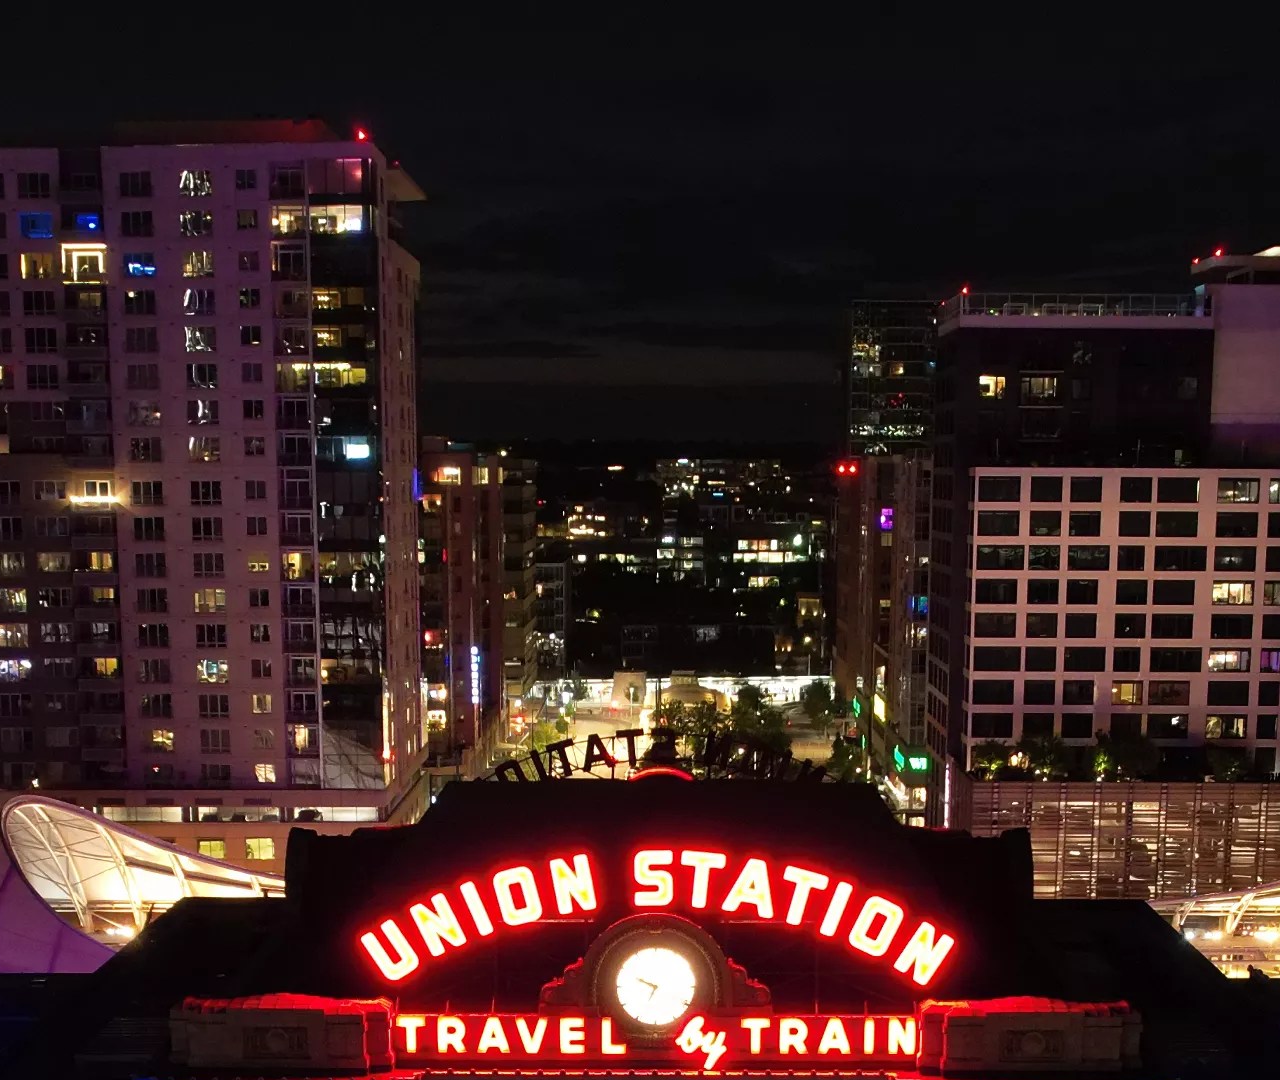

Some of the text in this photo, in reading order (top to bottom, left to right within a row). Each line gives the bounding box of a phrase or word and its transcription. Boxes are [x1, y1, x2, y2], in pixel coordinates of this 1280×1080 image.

[359, 849, 955, 986] UNION STATION
[397, 1015, 918, 1070] TRAVEL by TRAIN
